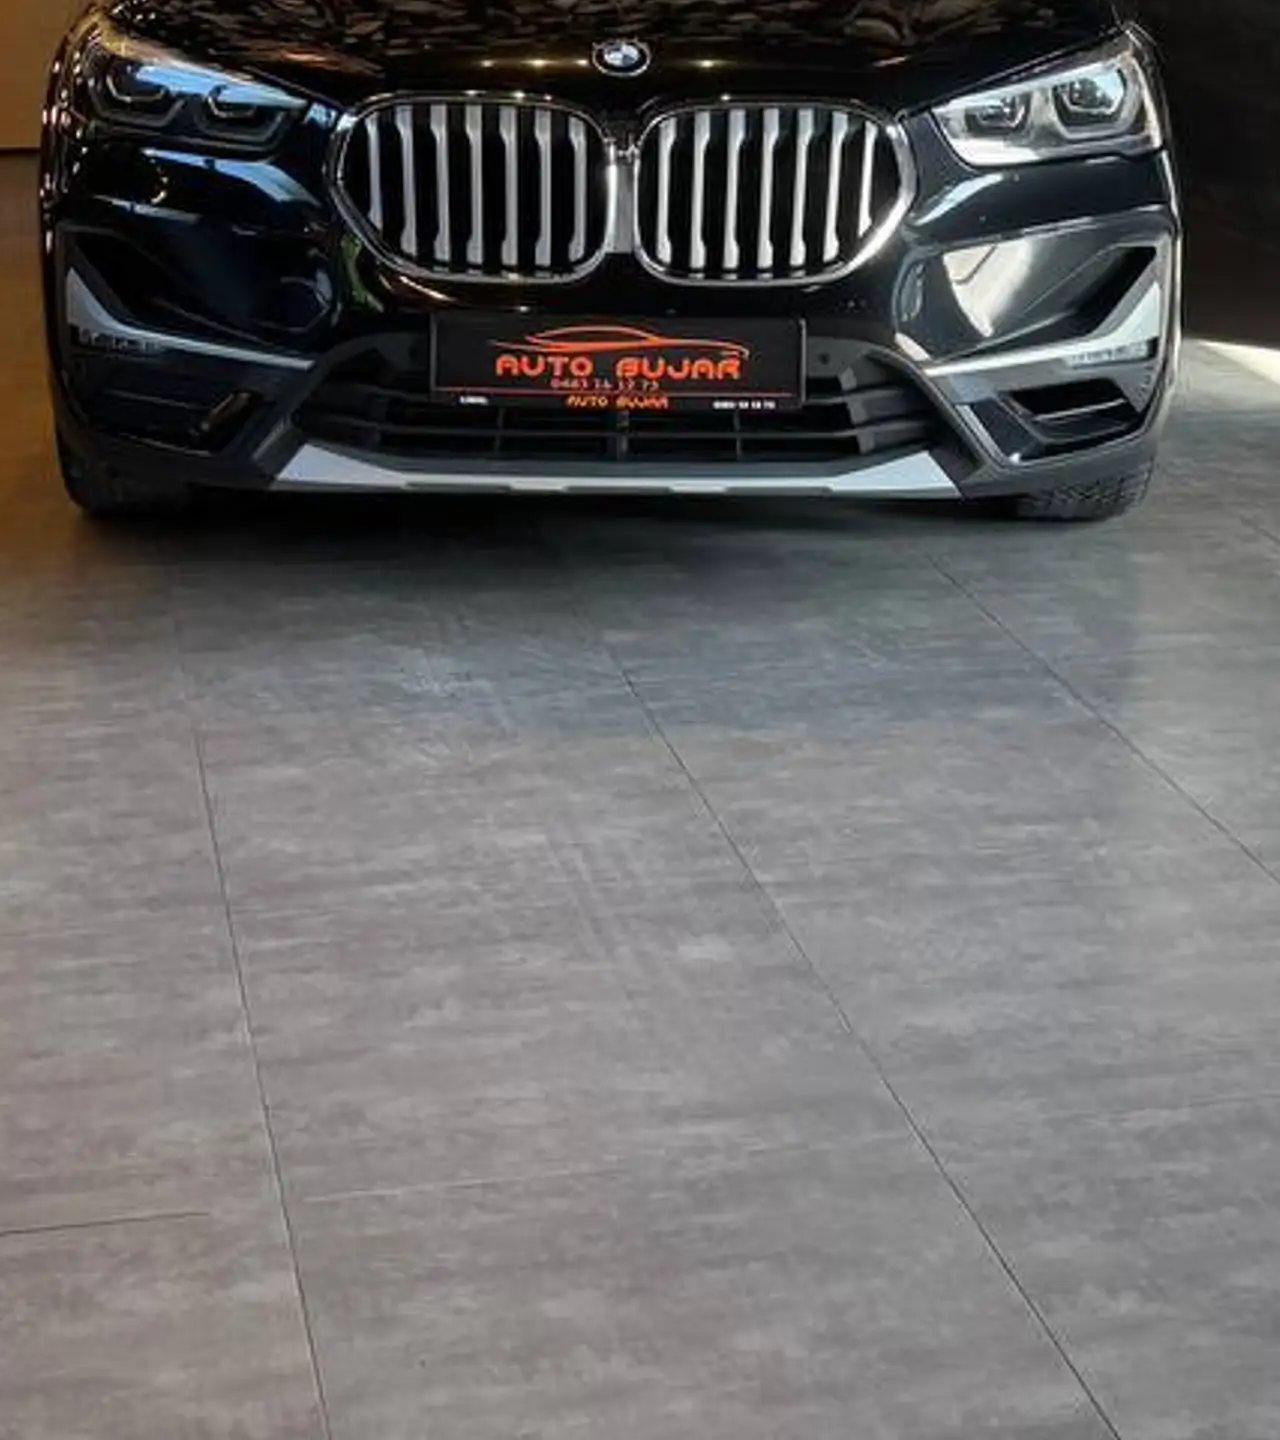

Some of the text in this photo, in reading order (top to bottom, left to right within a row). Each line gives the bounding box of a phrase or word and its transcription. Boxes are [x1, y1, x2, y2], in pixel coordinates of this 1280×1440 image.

[495, 354, 742, 382] AUTO BUJAR
[565, 394, 610, 409] AUTO
